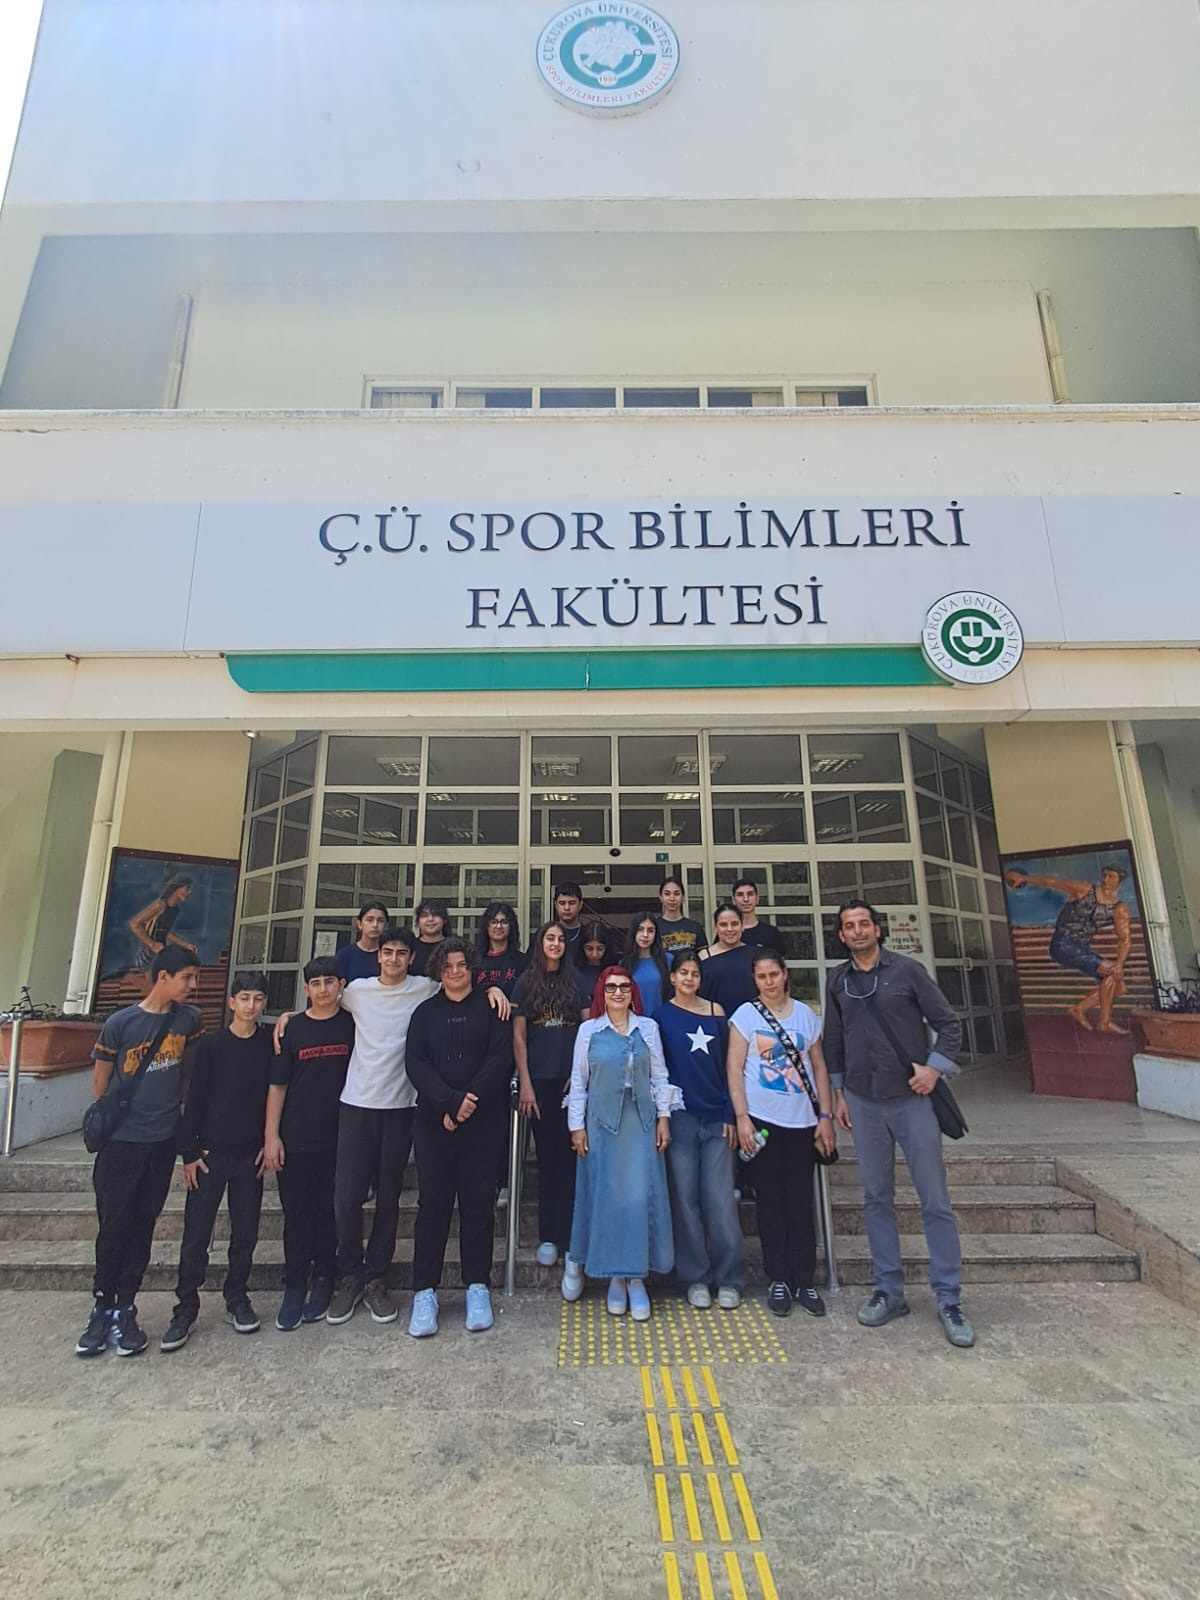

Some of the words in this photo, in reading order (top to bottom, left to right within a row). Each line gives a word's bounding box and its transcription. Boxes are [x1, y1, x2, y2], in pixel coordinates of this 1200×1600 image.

[319, 506, 428, 565] Ç.Ü.
[447, 511, 614, 551] SPOR
[629, 501, 970, 549] BİLİMLERİ
[466, 576, 828, 628] FAKÜLTESİ
